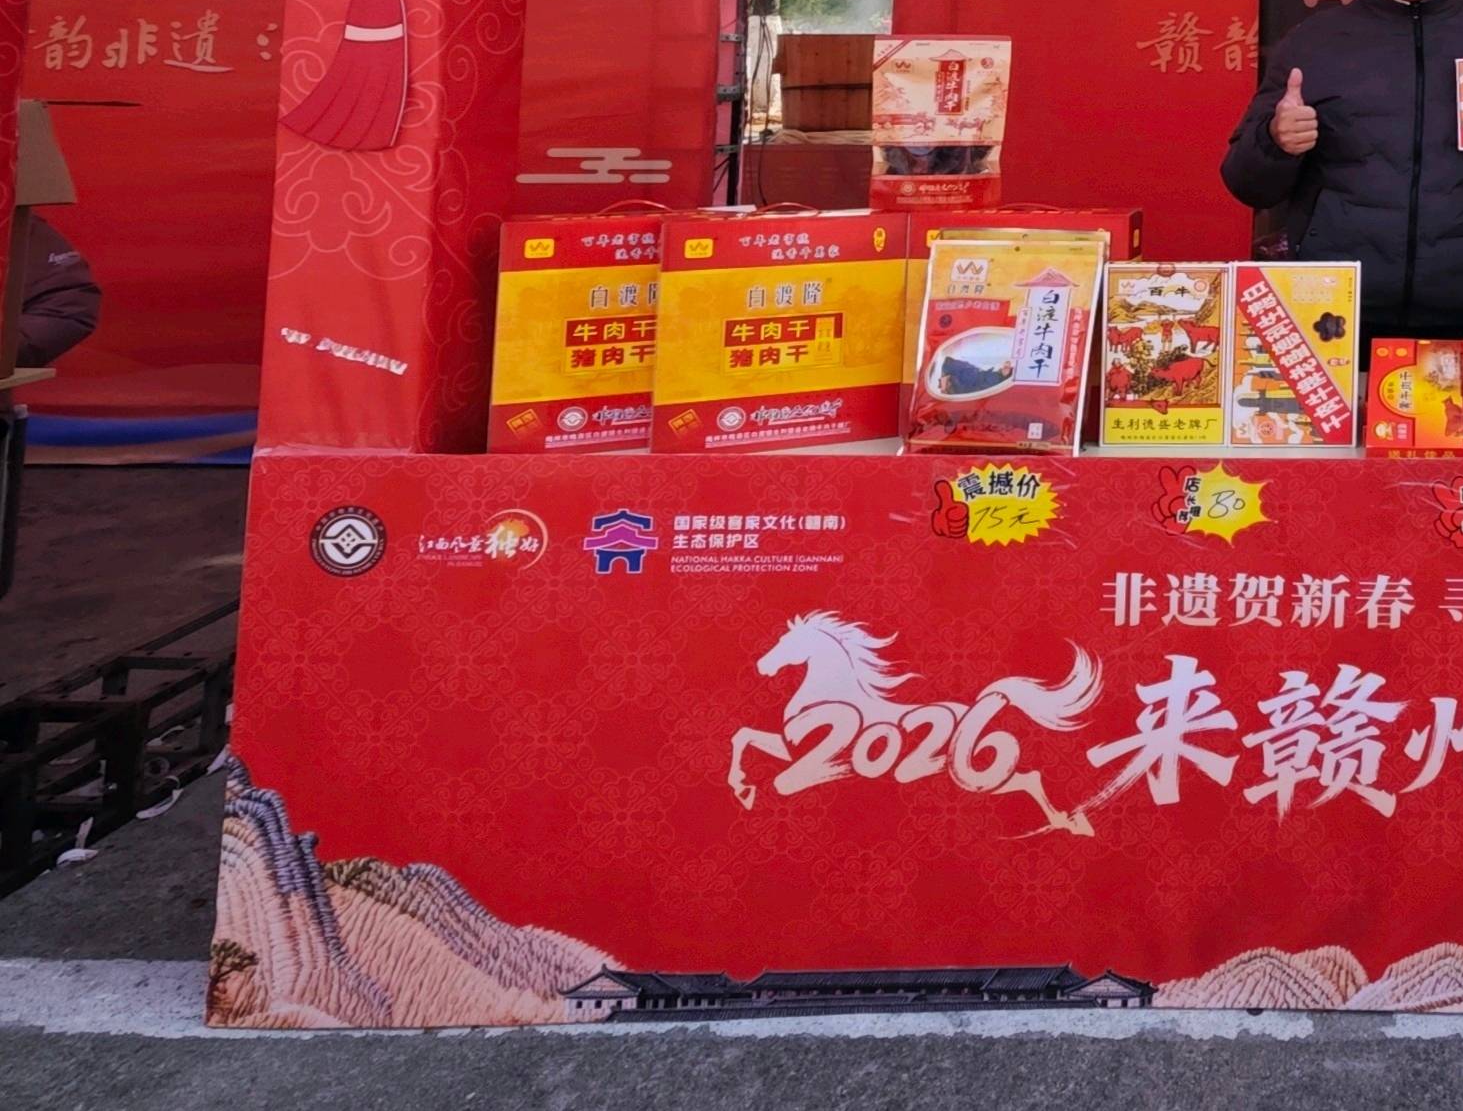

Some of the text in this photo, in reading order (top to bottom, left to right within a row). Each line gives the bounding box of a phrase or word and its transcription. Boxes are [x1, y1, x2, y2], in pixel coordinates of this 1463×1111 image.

[573, 319, 658, 342] 牛肉干
[731, 320, 810, 342] 牛肉干
[1028, 289, 1060, 379] 白渡牛肉干
[571, 343, 656, 369] 猪肉干
[729, 344, 809, 369] 猪肉干
[958, 471, 1041, 501] 震撼价
[672, 533, 759, 549] 生态保护区
[670, 564, 819, 573] ECOLOGICAL PROTECTION ZONE
[671, 555, 720, 563] NATIONAL
[721, 555, 752, 563] HAKKA
[754, 554, 793, 563] CULTURE
[1101, 572, 1415, 631] 非遗贺新春
[774, 689, 1022, 793] 2026
